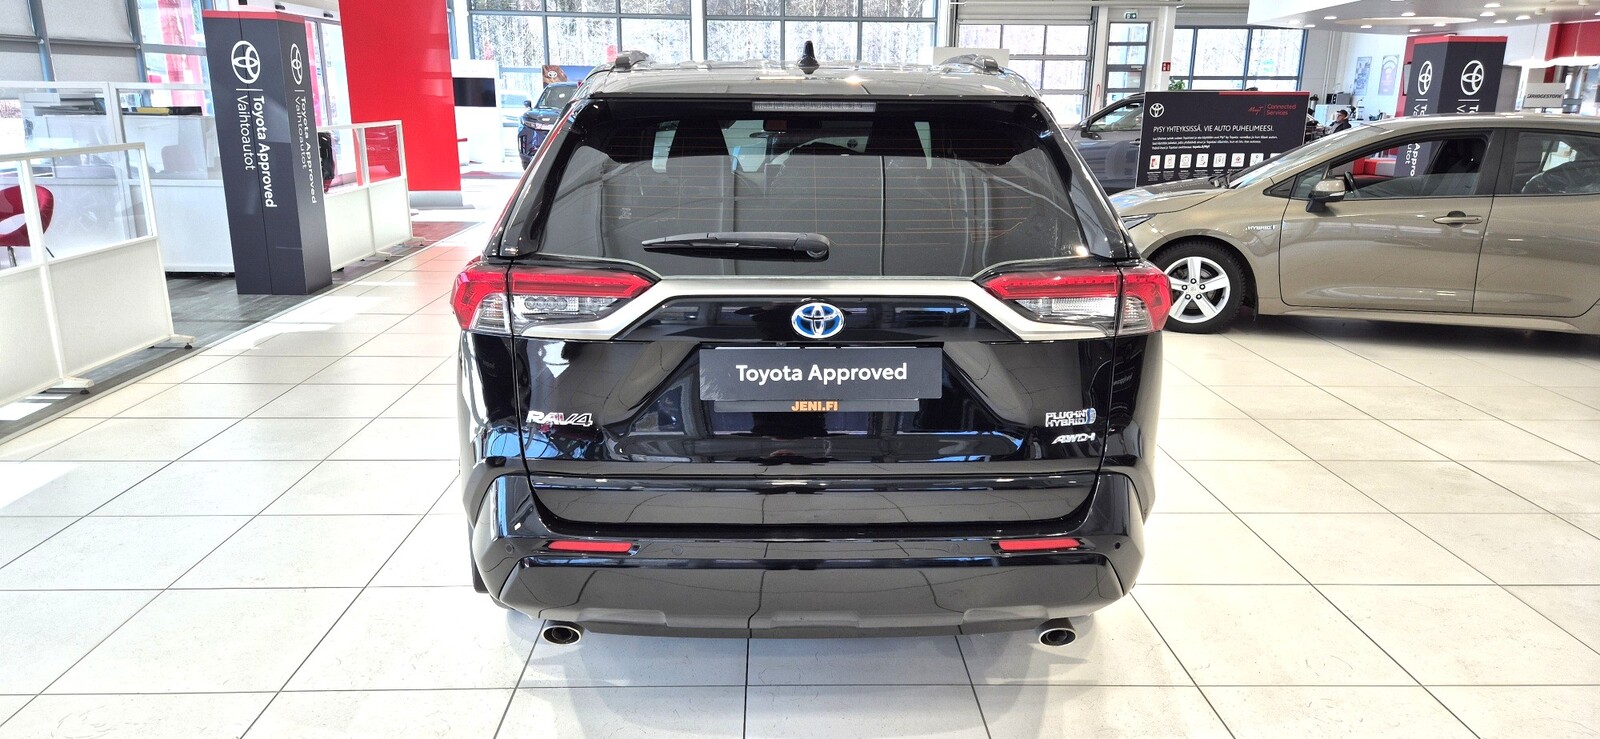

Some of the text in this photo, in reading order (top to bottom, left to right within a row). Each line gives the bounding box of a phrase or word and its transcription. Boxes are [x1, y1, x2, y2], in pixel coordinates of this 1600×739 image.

[237, 95, 256, 170] Vaihtoautot
[295, 96, 307, 169] Vaihtoautot
[252, 95, 278, 208] Toyota Approved
[300, 96, 317, 204] Toyota Approved
[1410, 143, 1421, 177] Appro
[736, 362, 908, 386] Toyota Approved
[526, 410, 593, 427] RAV4
[791, 401, 838, 412] JENI.FI
[1045, 418, 1087, 427] HYBRID
